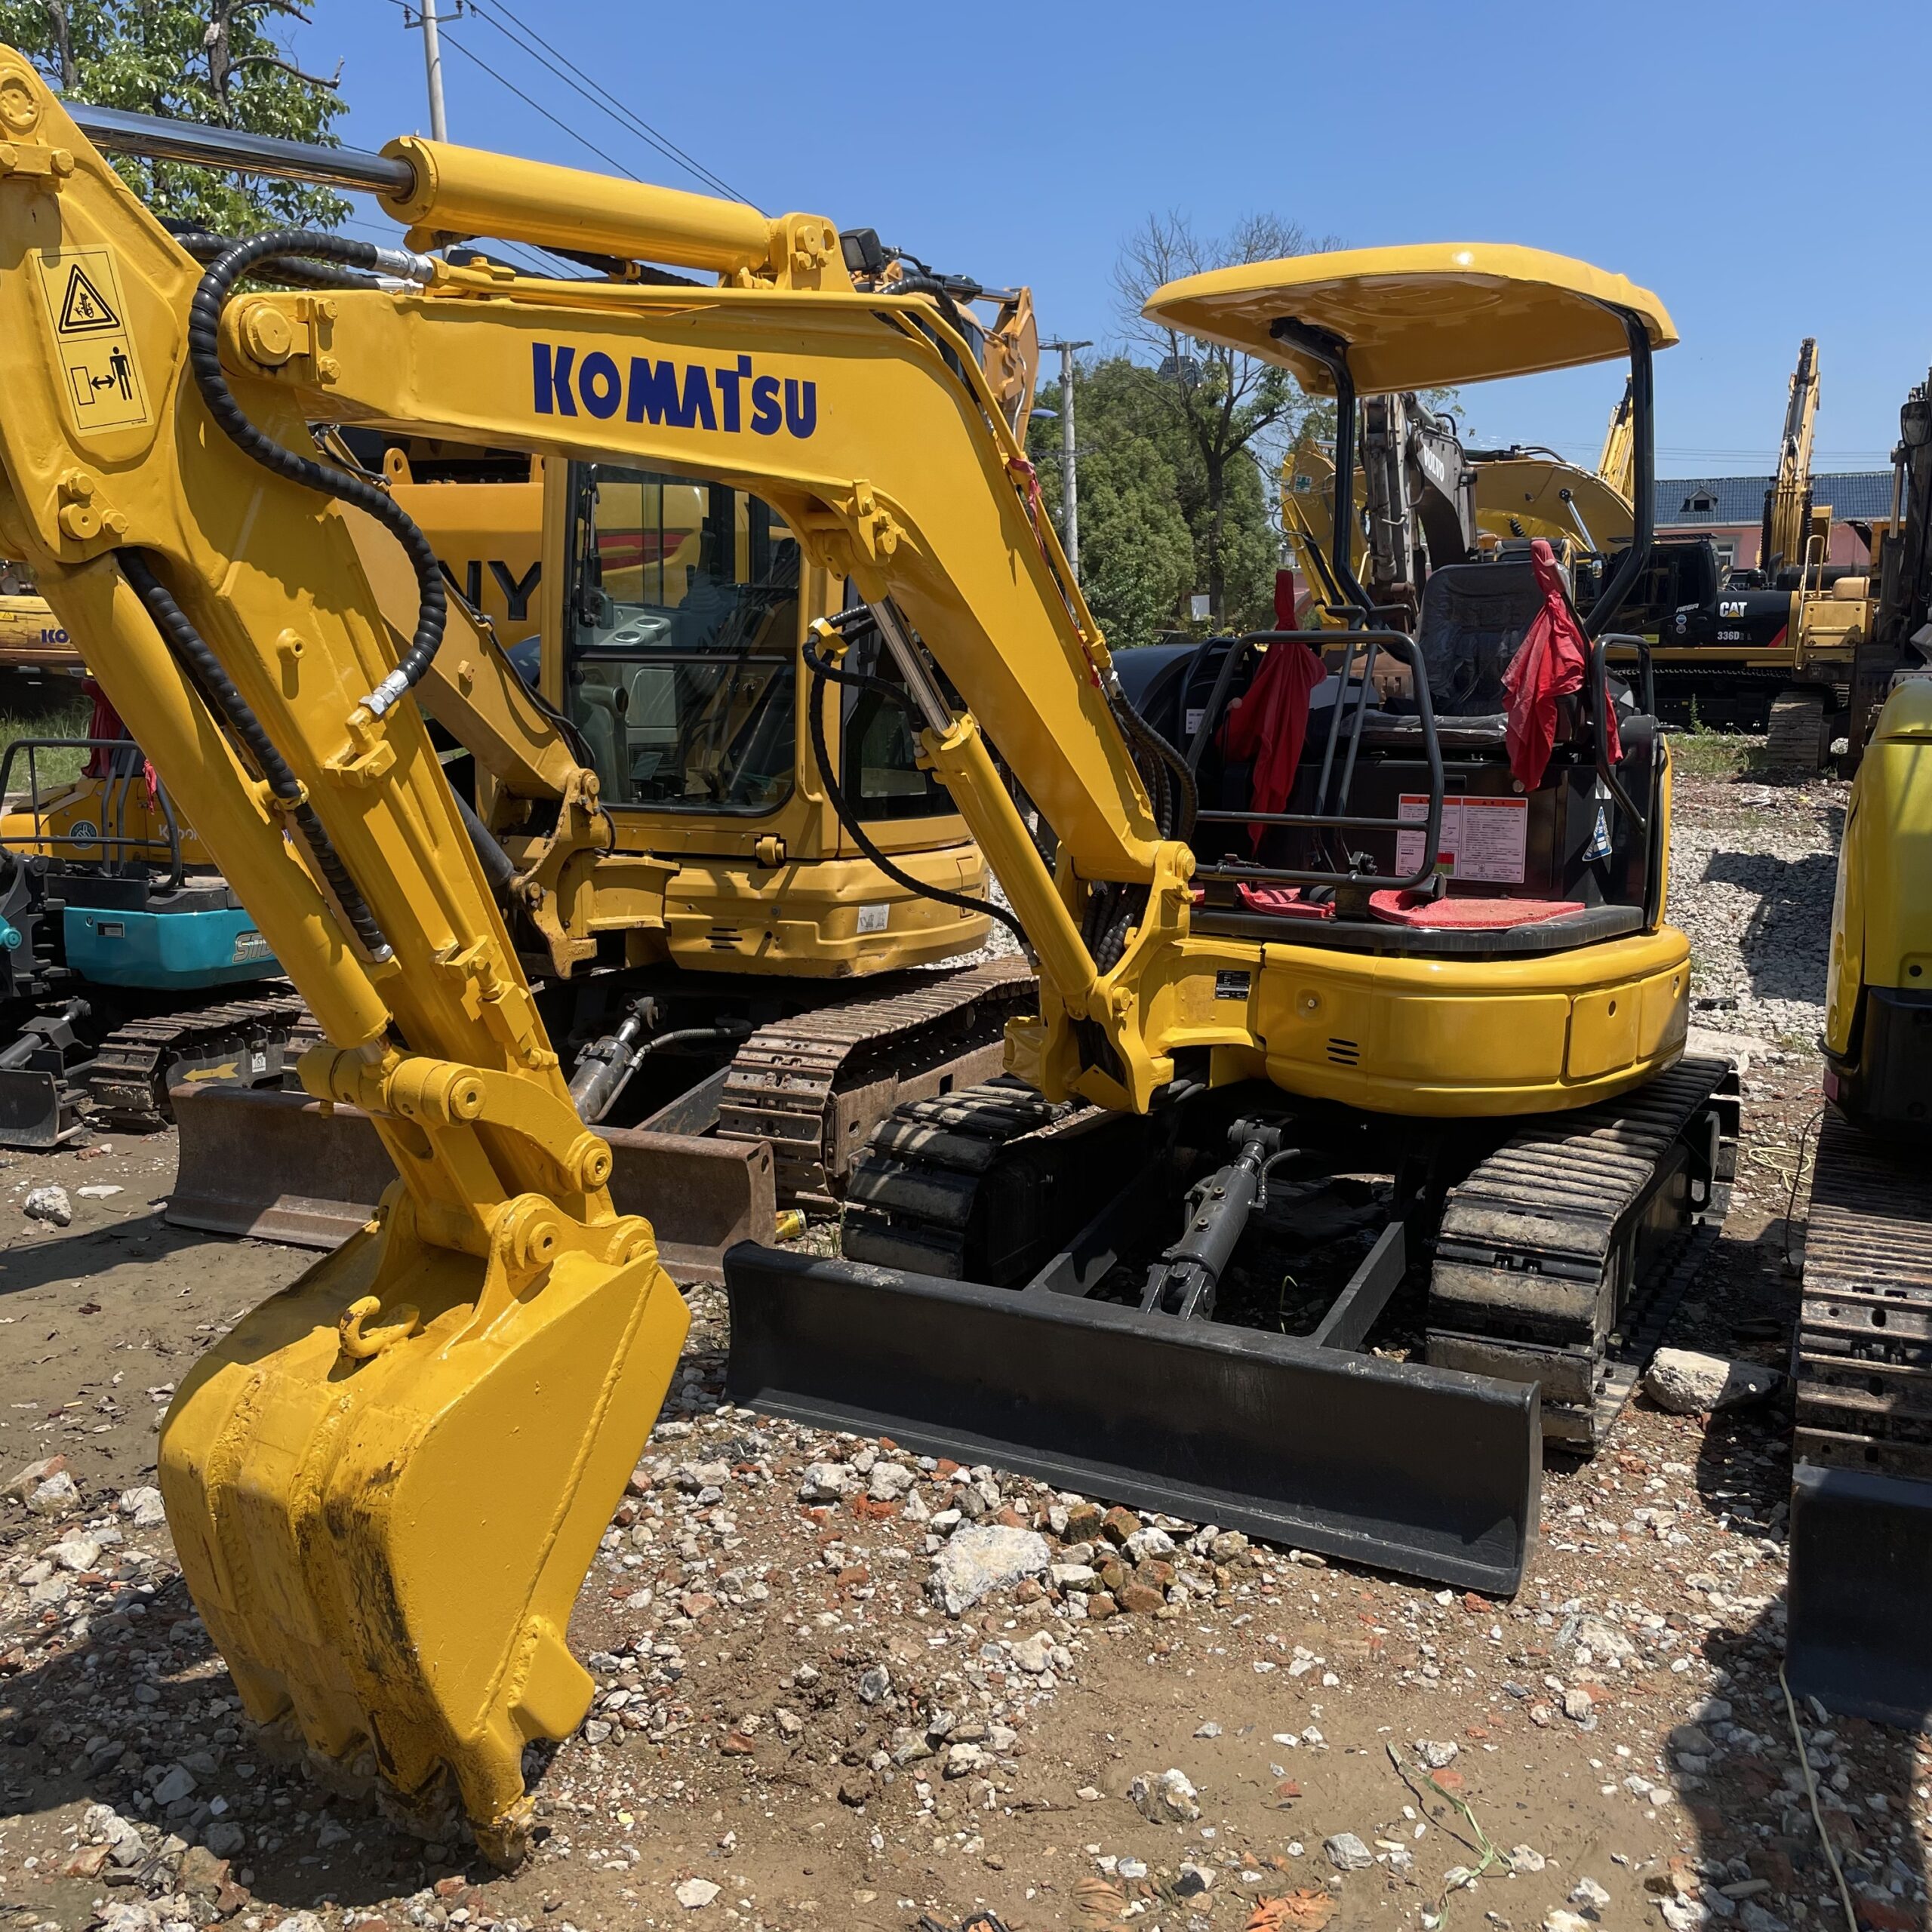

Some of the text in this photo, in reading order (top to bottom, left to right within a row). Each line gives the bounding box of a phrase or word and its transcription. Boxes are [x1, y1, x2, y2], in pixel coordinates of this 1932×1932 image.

[532, 342, 817, 439] KOMATSU
[1423, 444, 1444, 482] VOLVO
[1719, 601, 1748, 618] CAT
